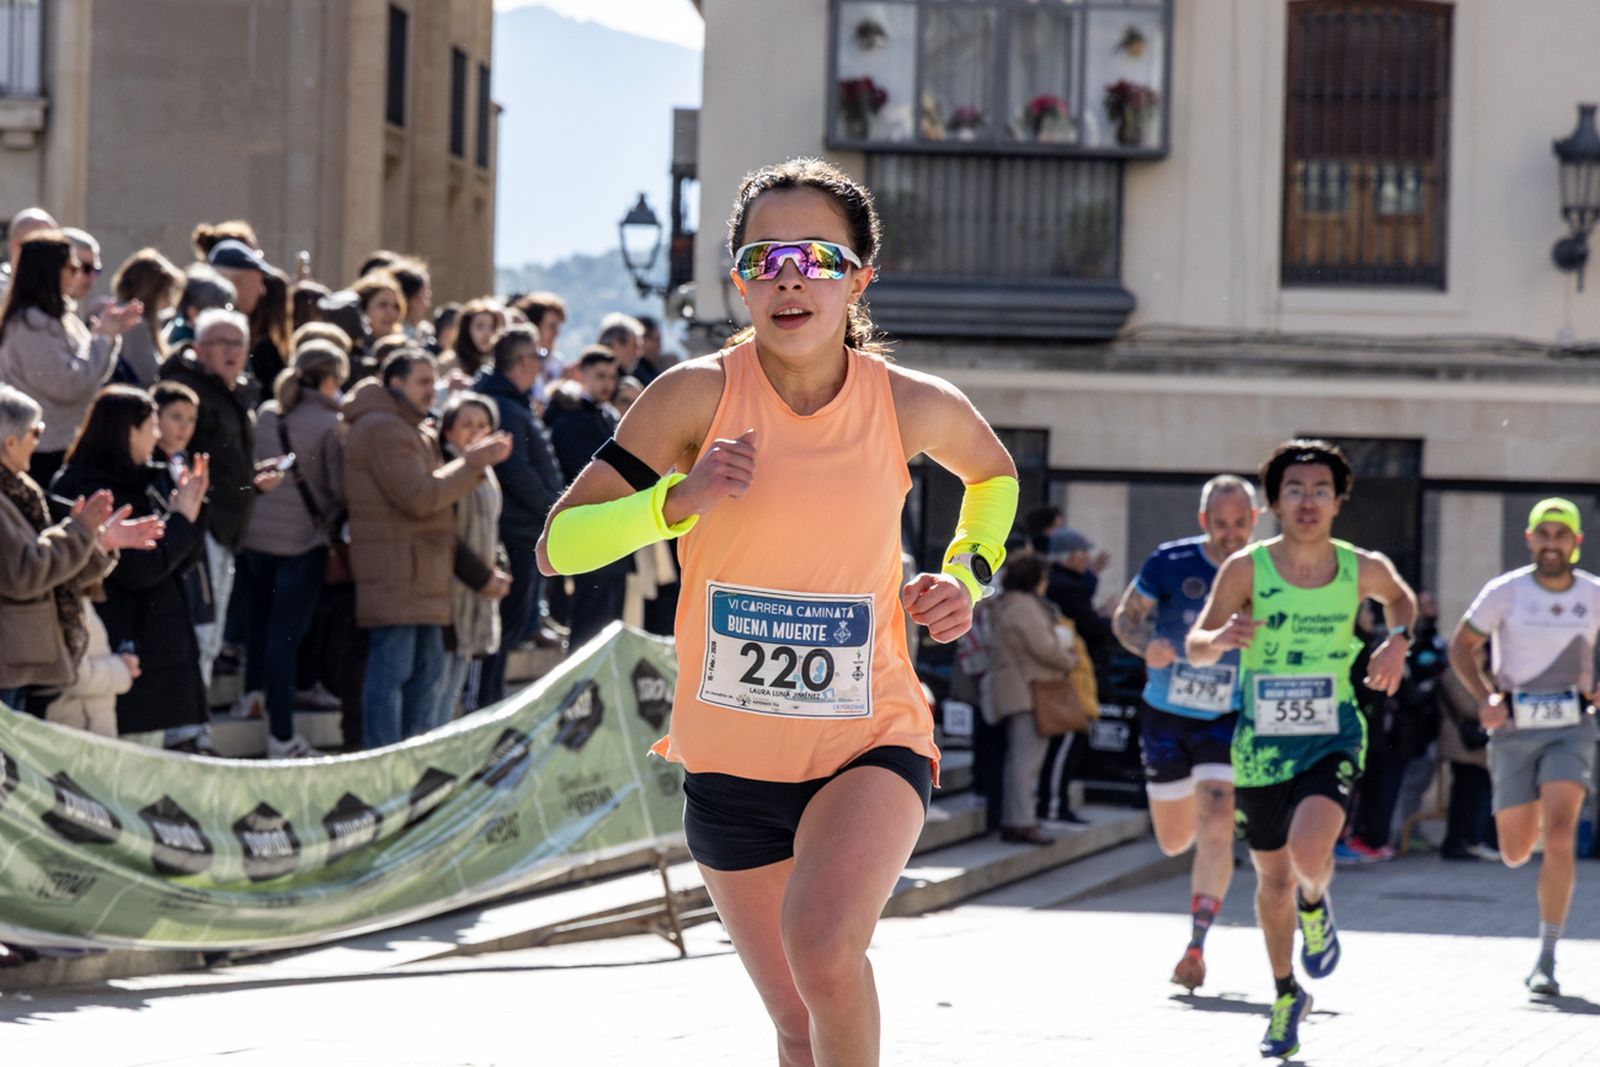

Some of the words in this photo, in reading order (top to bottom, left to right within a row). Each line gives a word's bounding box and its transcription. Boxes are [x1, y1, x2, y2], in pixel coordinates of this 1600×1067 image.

[728, 598, 739, 610] VI
[741, 599, 793, 616] CARRERA
[796, 606, 855, 619] CAMINATA
[728, 615, 768, 637] BUENA
[772, 621, 827, 642] MUERTE
[739, 642, 835, 692] 220
[749, 687, 771, 697] LAURA
[772, 690, 791, 698] LUNA
[1183, 680, 1217, 697] 479
[1275, 701, 1316, 723] 555
